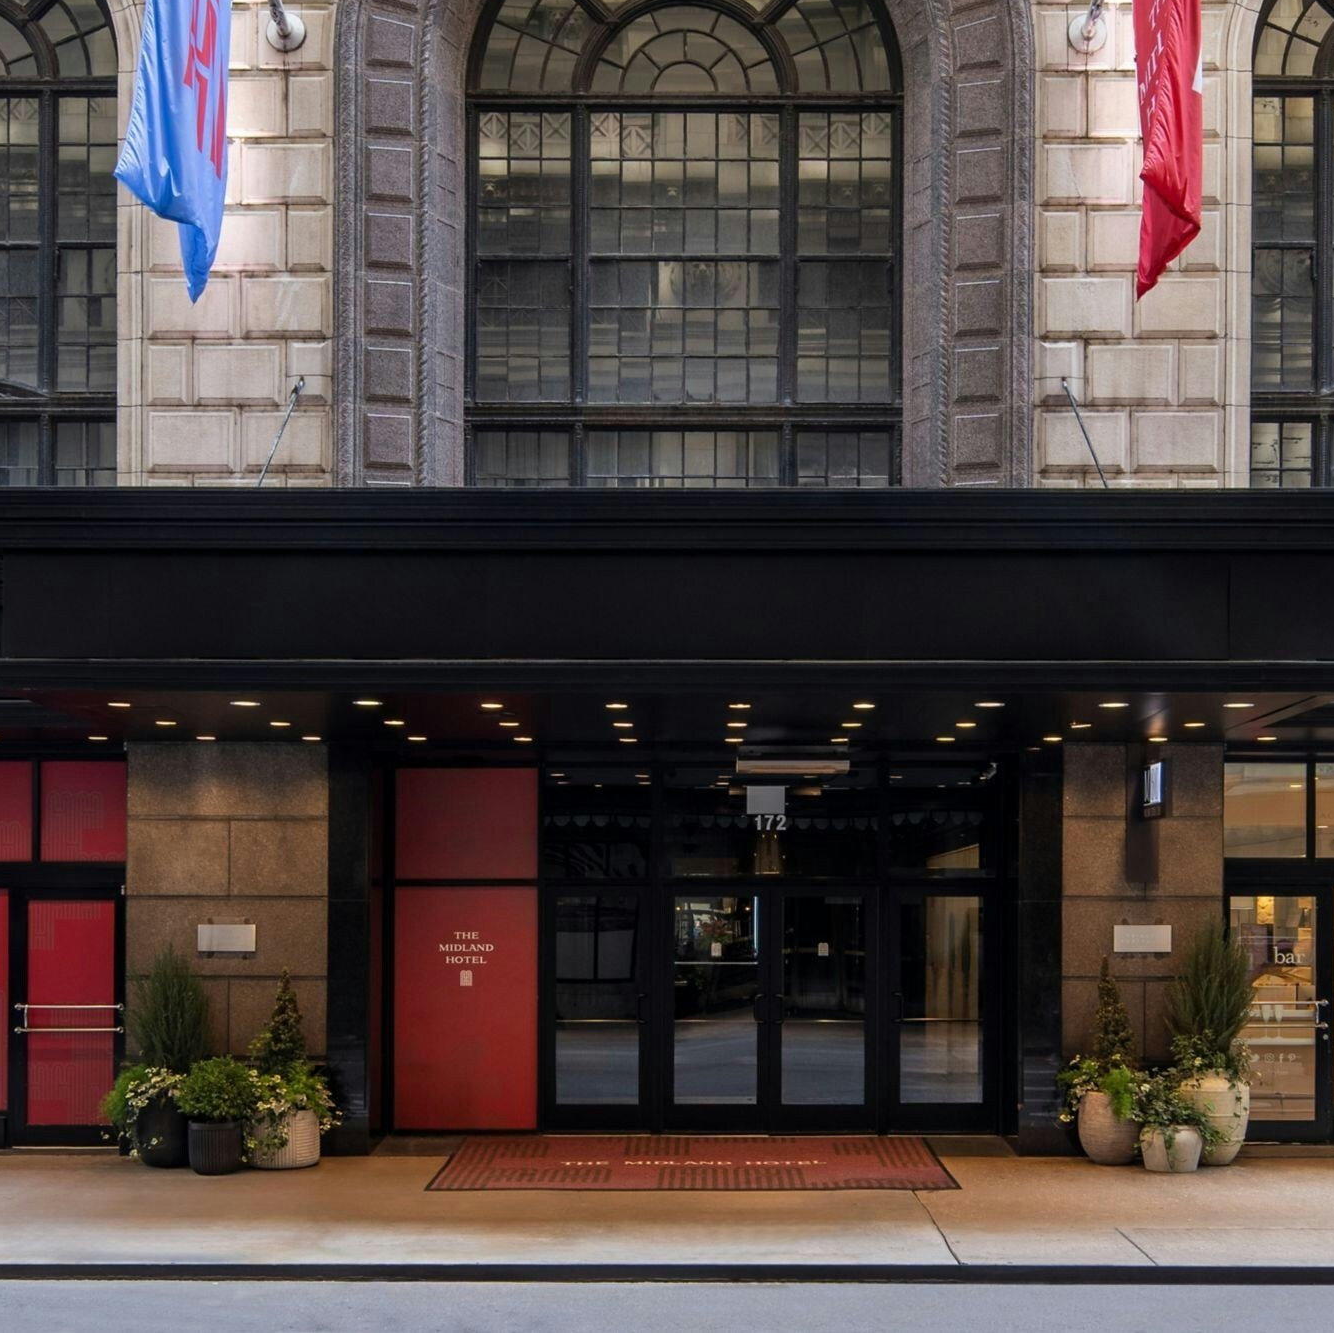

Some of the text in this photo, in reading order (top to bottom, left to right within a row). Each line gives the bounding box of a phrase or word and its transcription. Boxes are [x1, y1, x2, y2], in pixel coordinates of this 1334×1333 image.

[754, 814, 787, 831] 172
[453, 931, 479, 940] THE
[439, 943, 494, 952] MIDLAND
[445, 955, 487, 964] HOTEL
[1273, 946, 1306, 965] bar
